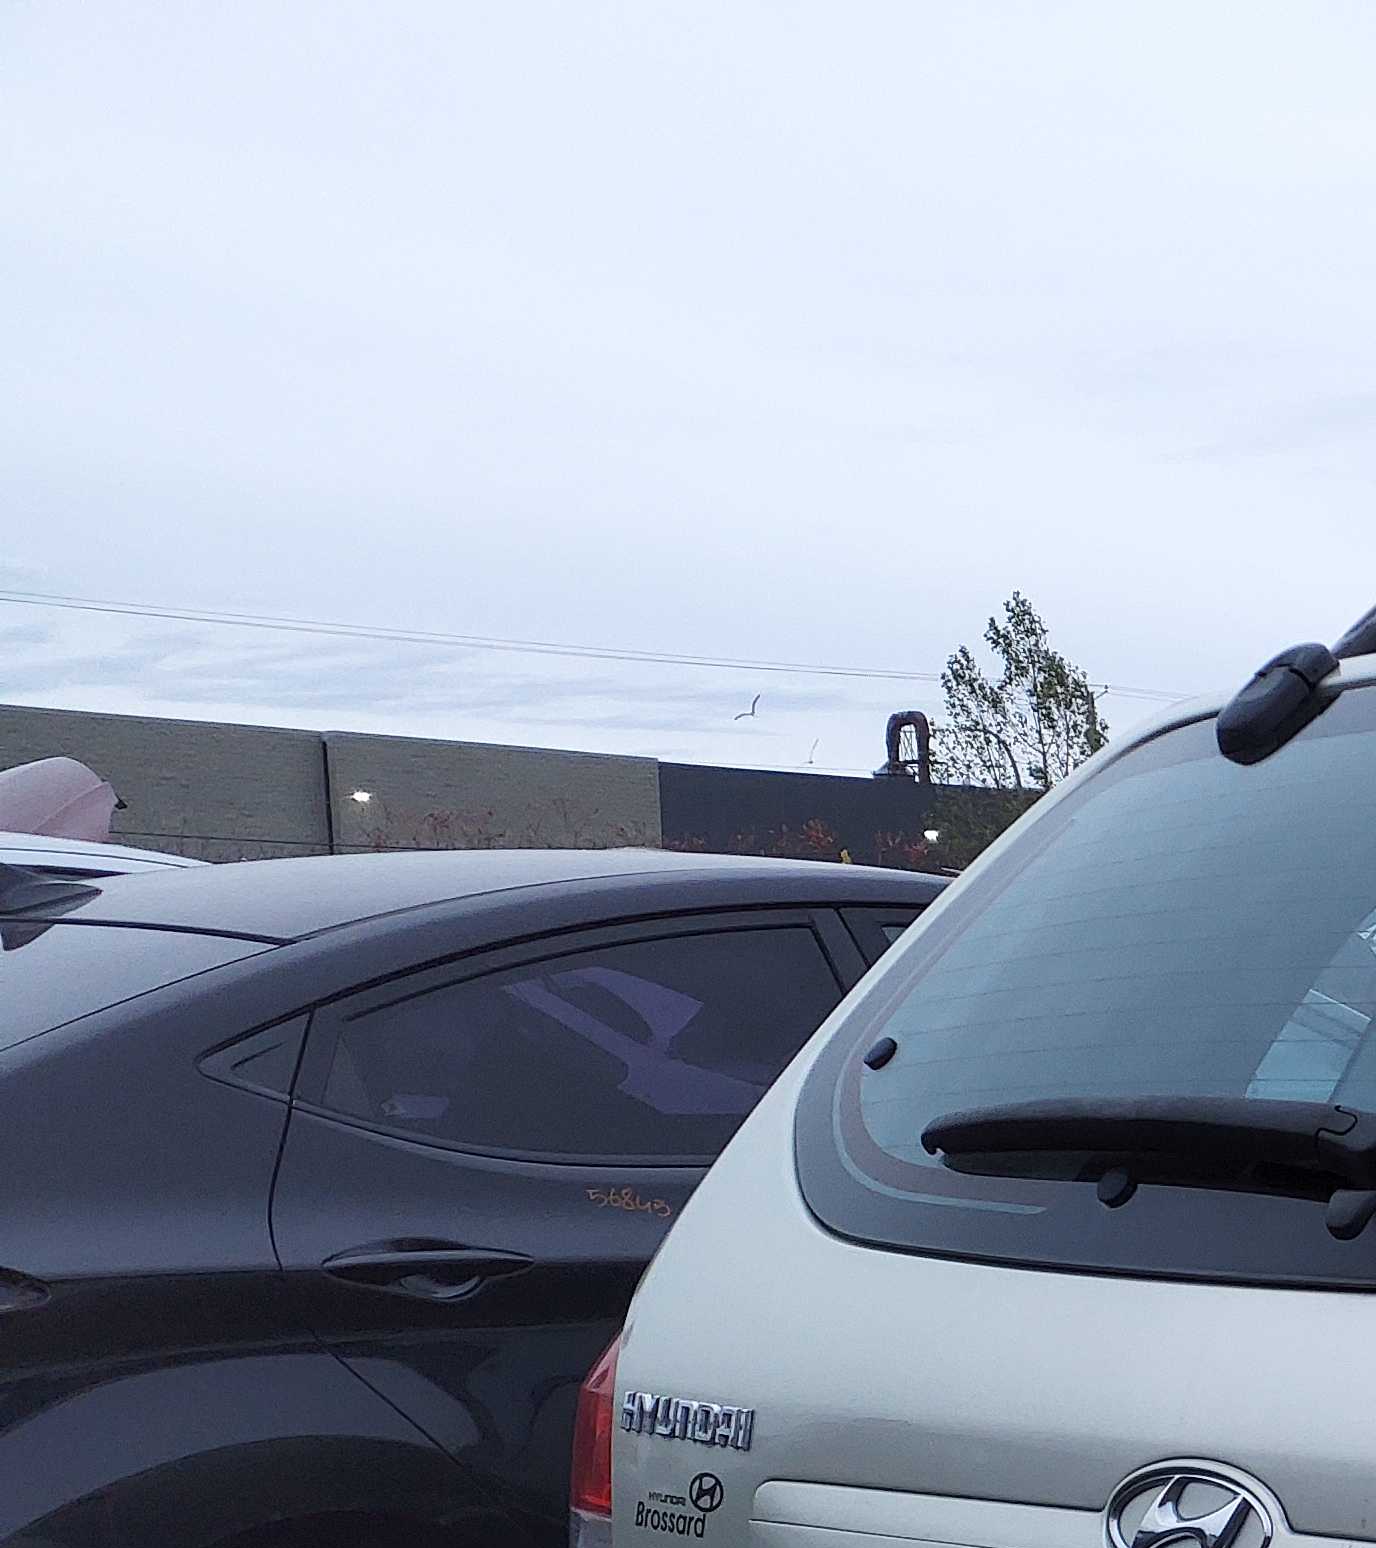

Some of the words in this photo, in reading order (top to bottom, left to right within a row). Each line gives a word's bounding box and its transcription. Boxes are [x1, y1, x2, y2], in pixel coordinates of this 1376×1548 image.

[585, 1187, 672, 1217] 56843
[621, 1391, 754, 1450] HYUNDAI
[635, 1501, 706, 1538] Brossard
